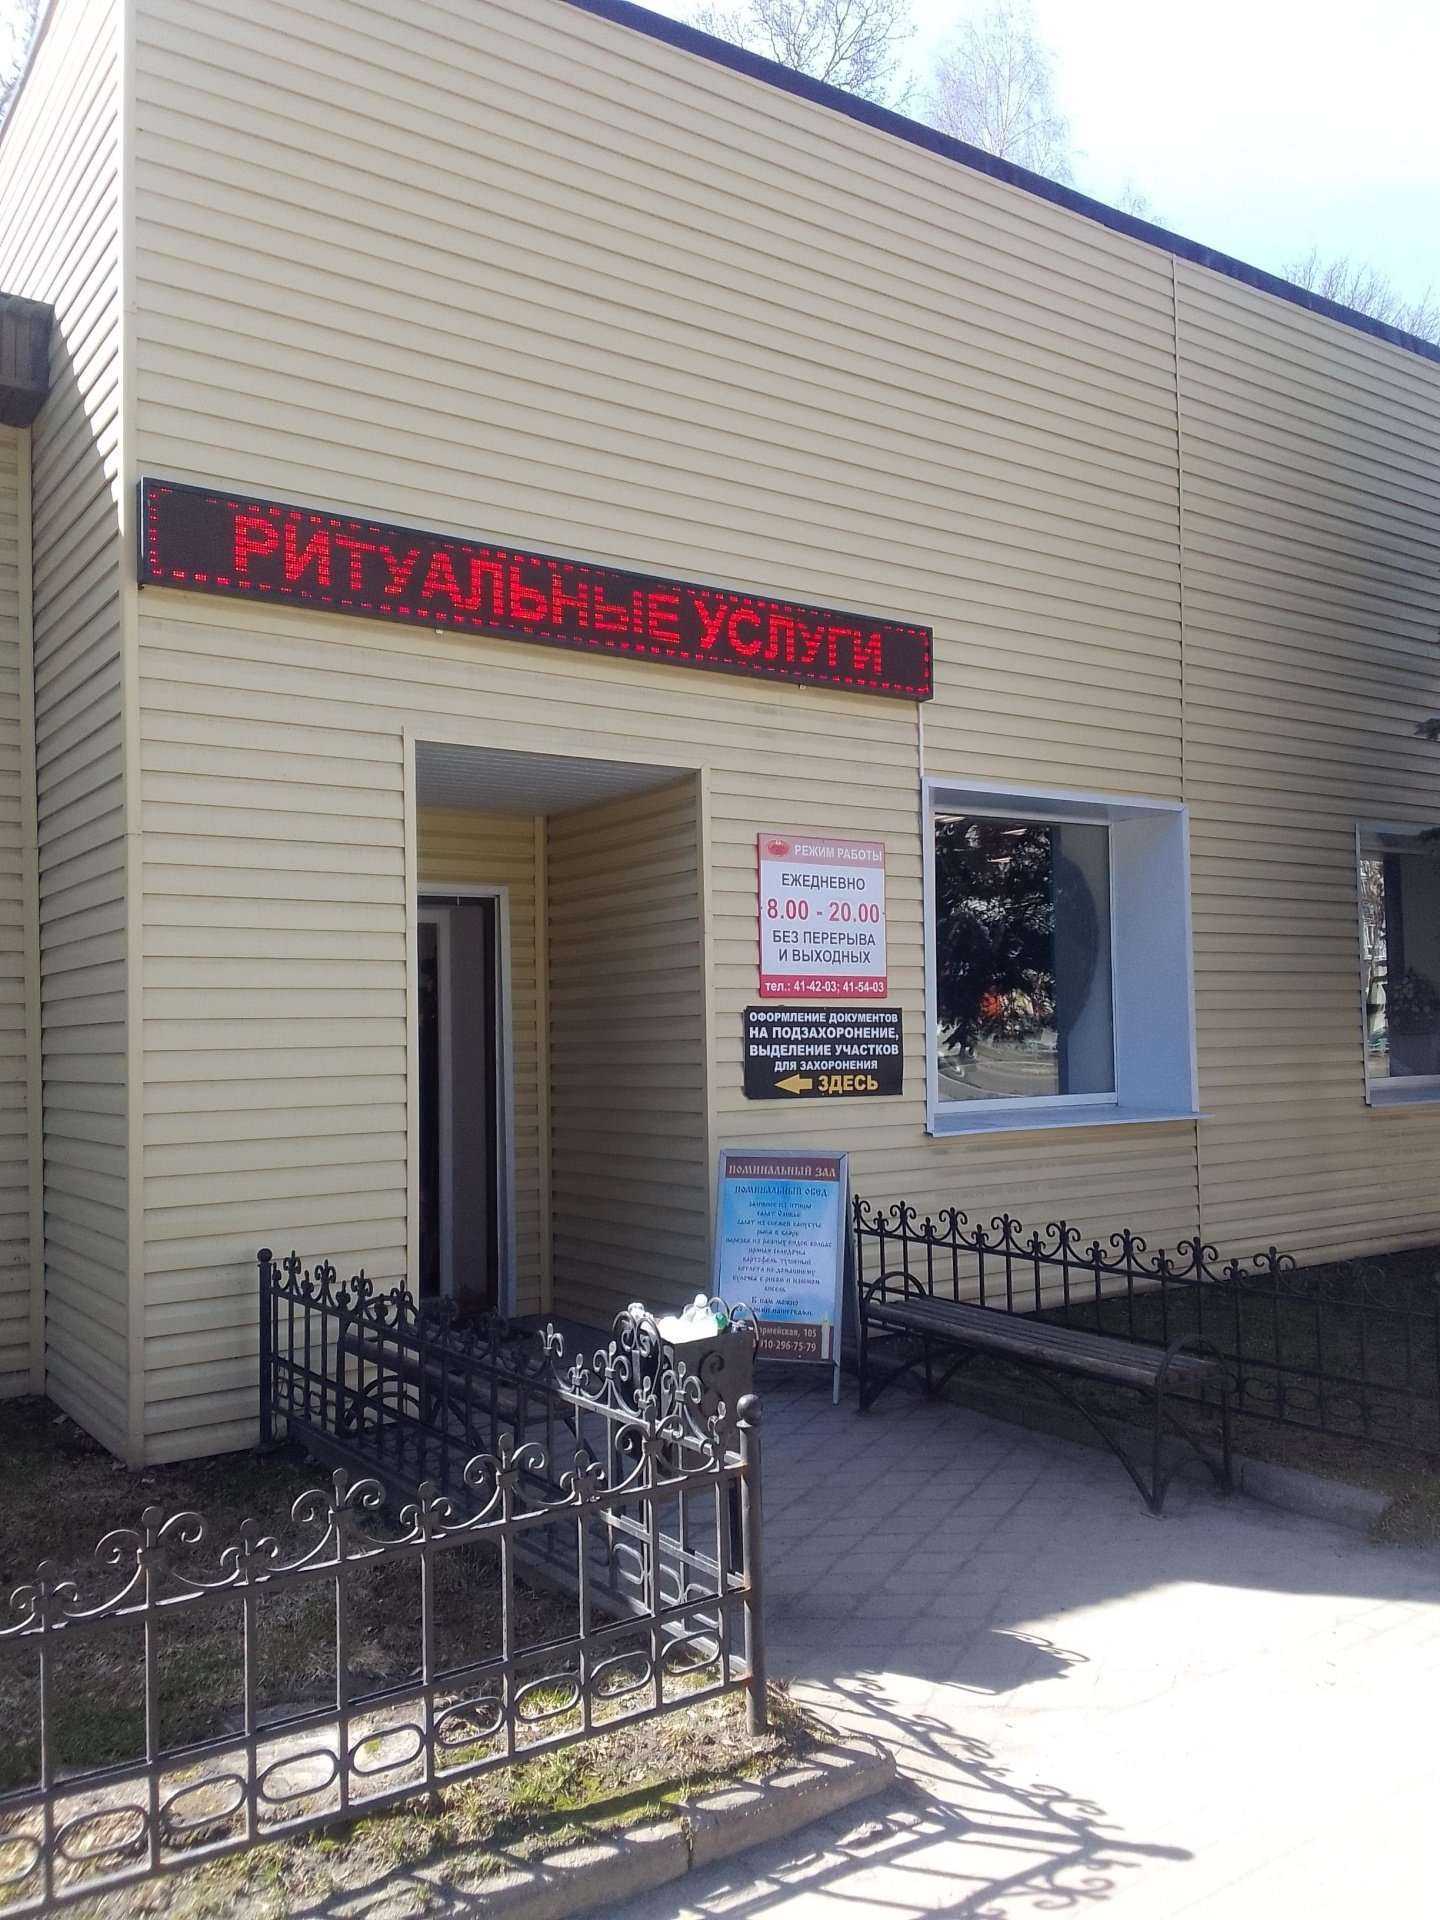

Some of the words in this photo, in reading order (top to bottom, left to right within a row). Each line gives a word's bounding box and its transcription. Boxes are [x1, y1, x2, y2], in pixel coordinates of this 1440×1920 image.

[232, 513, 681, 644] РИТУАЛЬНЫЕ
[694, 598, 883, 676] УСЛУГИ
[794, 845, 834, 858] РЕЖИМ
[838, 847, 881, 861] РАБОТЫ
[782, 873, 865, 891] ЕЖЕДНЕВНО
[767, 898, 808, 920] 8.00
[829, 902, 880, 923] 20.00
[773, 930, 798, 943] БЕЗ
[804, 931, 875, 946] ПЕРЕРЫВА
[779, 949, 787, 961] И
[793, 949, 871, 965] ВЫХОДНЫХ
[765, 981, 790, 991] тел.:
[794, 981, 840, 993] 41-42-03;
[843, 981, 884, 992] 41-54-03
[750, 1012, 826, 1022] ОФОРМЛЕНИЕ
[829, 1013, 898, 1024] ДОКУМЕНТОВ
[750, 1027, 768, 1038] НА
[773, 1027, 899, 1040] ПОДЗАХОРОНЕНИЕ,
[750, 1045, 831, 1057] ВЫДЕЛЕНИЕ
[835, 1045, 899, 1055] УЧАСТКОВ
[775, 1061, 796, 1072] ДЛЯ
[800, 1060, 877, 1070] ЗАХОРОНЕНИЯ
[818, 1075, 878, 1094] ЗДЕСЬ
[729, 1164, 812, 1176] ПОМИНАЛЬНЫЙ
[815, 1167, 836, 1177] ЗАЛ
[804, 1328, 816, 1337] 105
